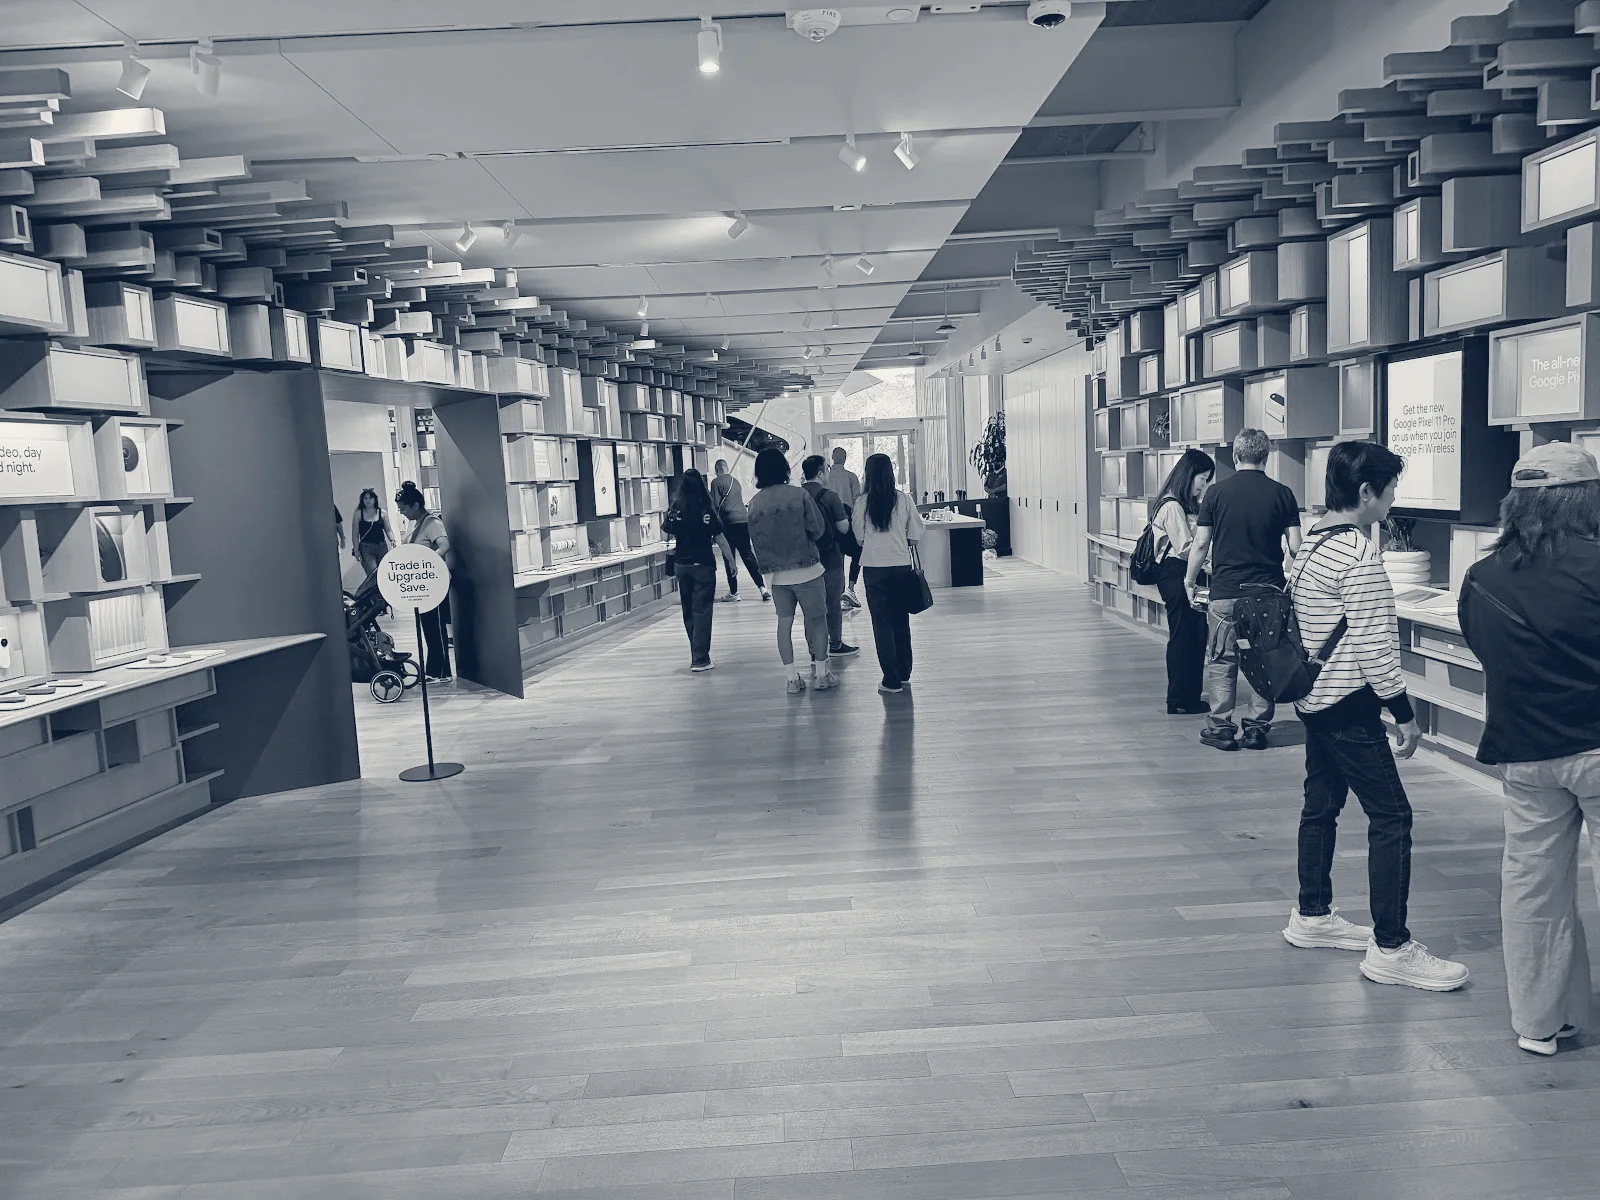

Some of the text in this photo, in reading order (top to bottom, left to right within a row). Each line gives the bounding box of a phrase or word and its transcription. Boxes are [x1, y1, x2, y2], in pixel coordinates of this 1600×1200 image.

[1531, 358, 1550, 372] The
[1529, 372, 1565, 389] Google
[1403, 403, 1445, 415] Get the new
[1393, 414, 1456, 431] Google Pixel 11 Pro
[1392, 428, 1457, 443] on us when you join
[23, 446, 42, 460] day
[1393, 442, 1455, 457] Google Fi Wireless
[6, 461, 36, 476] night.
[388, 559, 435, 571] Trade in.
[387, 570, 438, 584] Upgrade.
[399, 582, 429, 593] Save.
